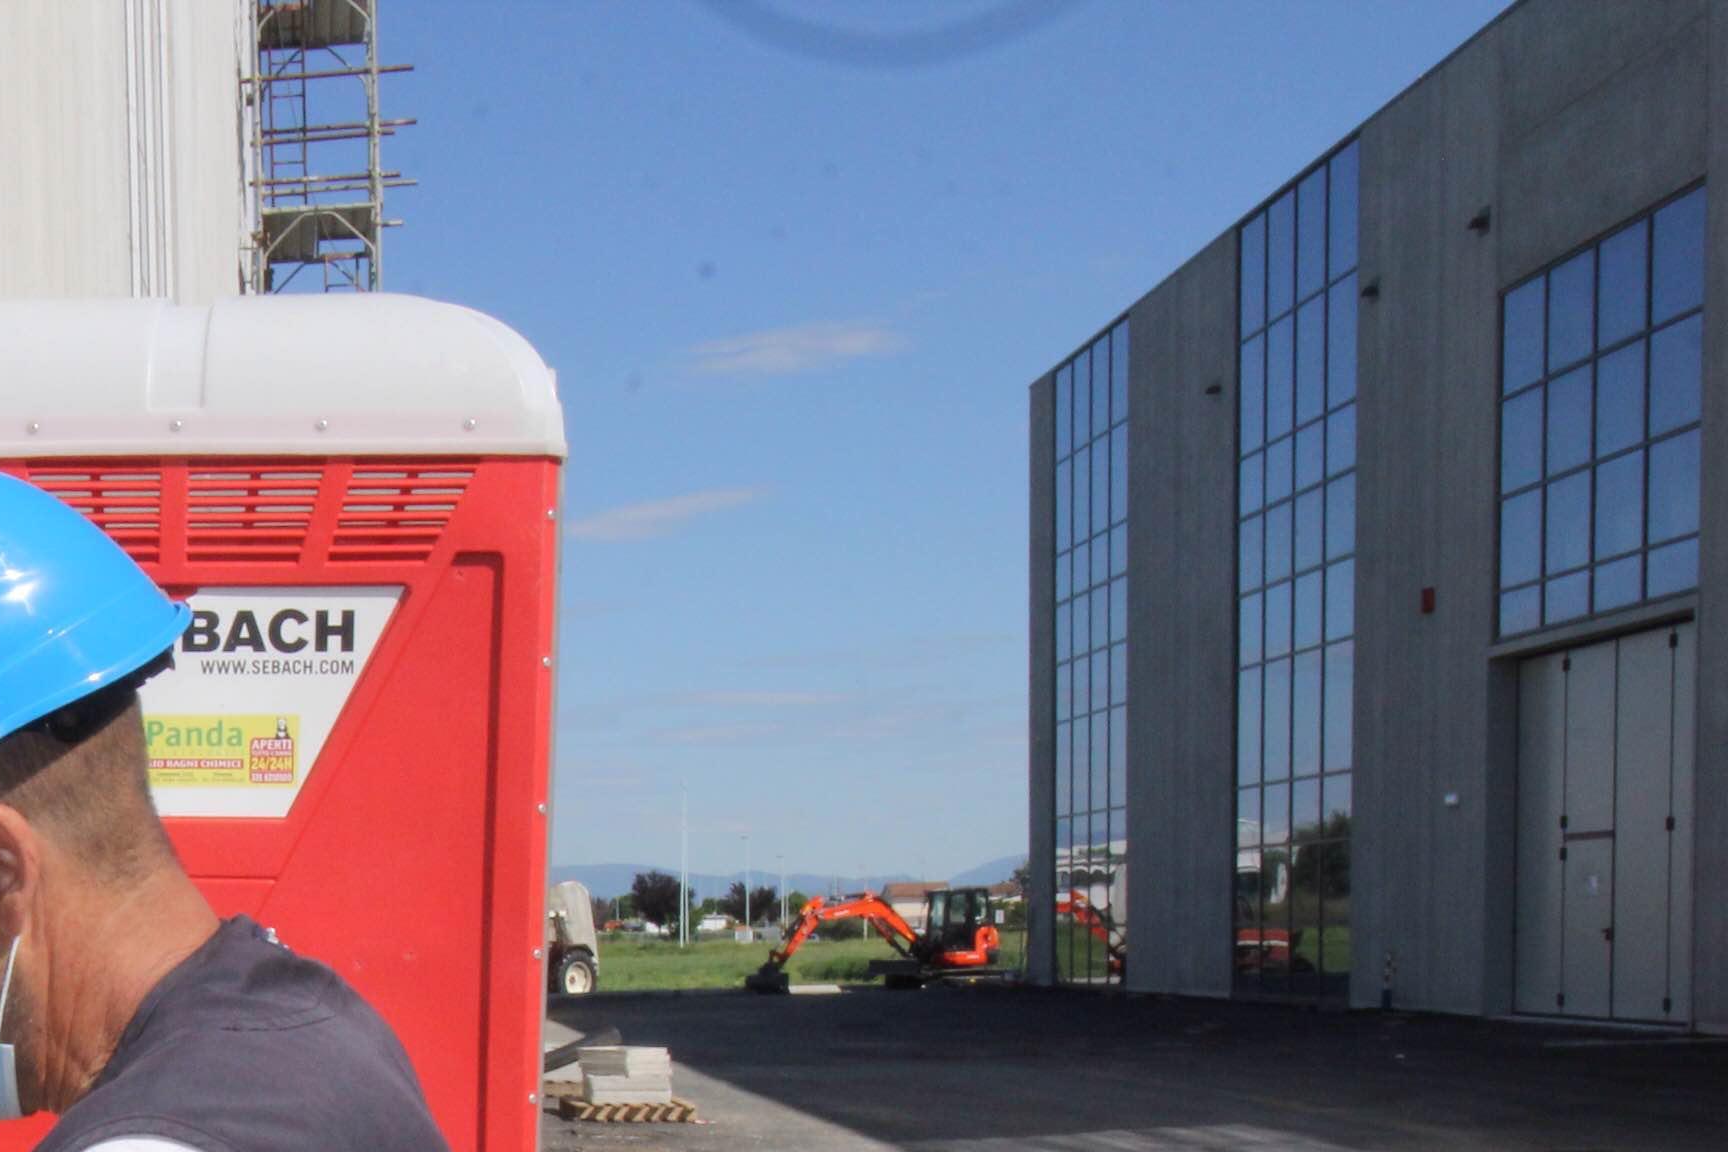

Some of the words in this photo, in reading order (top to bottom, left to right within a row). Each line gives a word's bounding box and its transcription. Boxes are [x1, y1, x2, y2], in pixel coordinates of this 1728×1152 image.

[182, 608, 355, 653] BACH
[201, 659, 354, 674] WWW.SEBACH.COM
[147, 720, 242, 747] Panda
[252, 739, 292, 750] APERTI
[166, 760, 198, 768] BAGNI
[200, 760, 241, 768] CHIMICI
